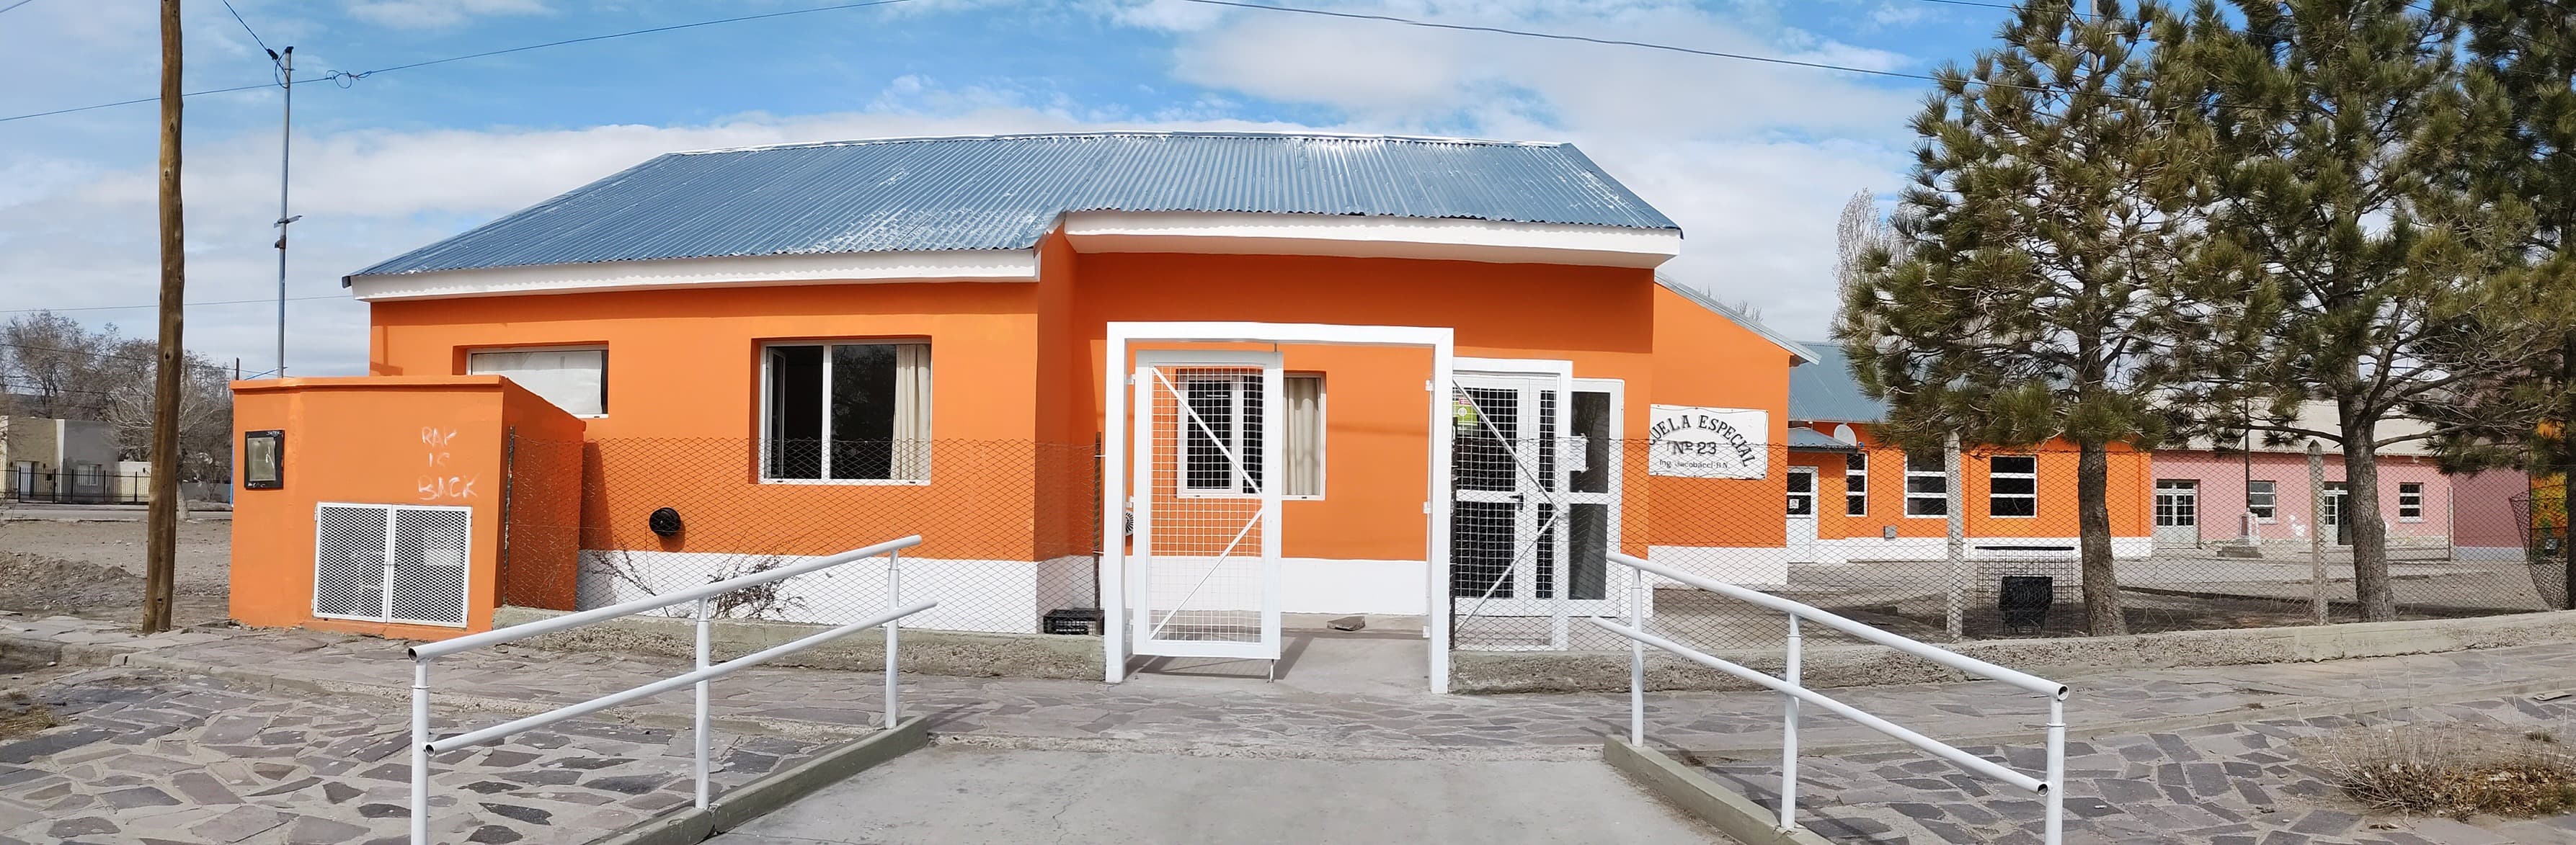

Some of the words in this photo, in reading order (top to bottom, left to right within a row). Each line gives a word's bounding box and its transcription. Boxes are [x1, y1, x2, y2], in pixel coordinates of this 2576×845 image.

[1697, 415, 1755, 467] ESPECIAL
[1697, 442, 1717, 455] 23
[417, 473, 479, 501] BACK
